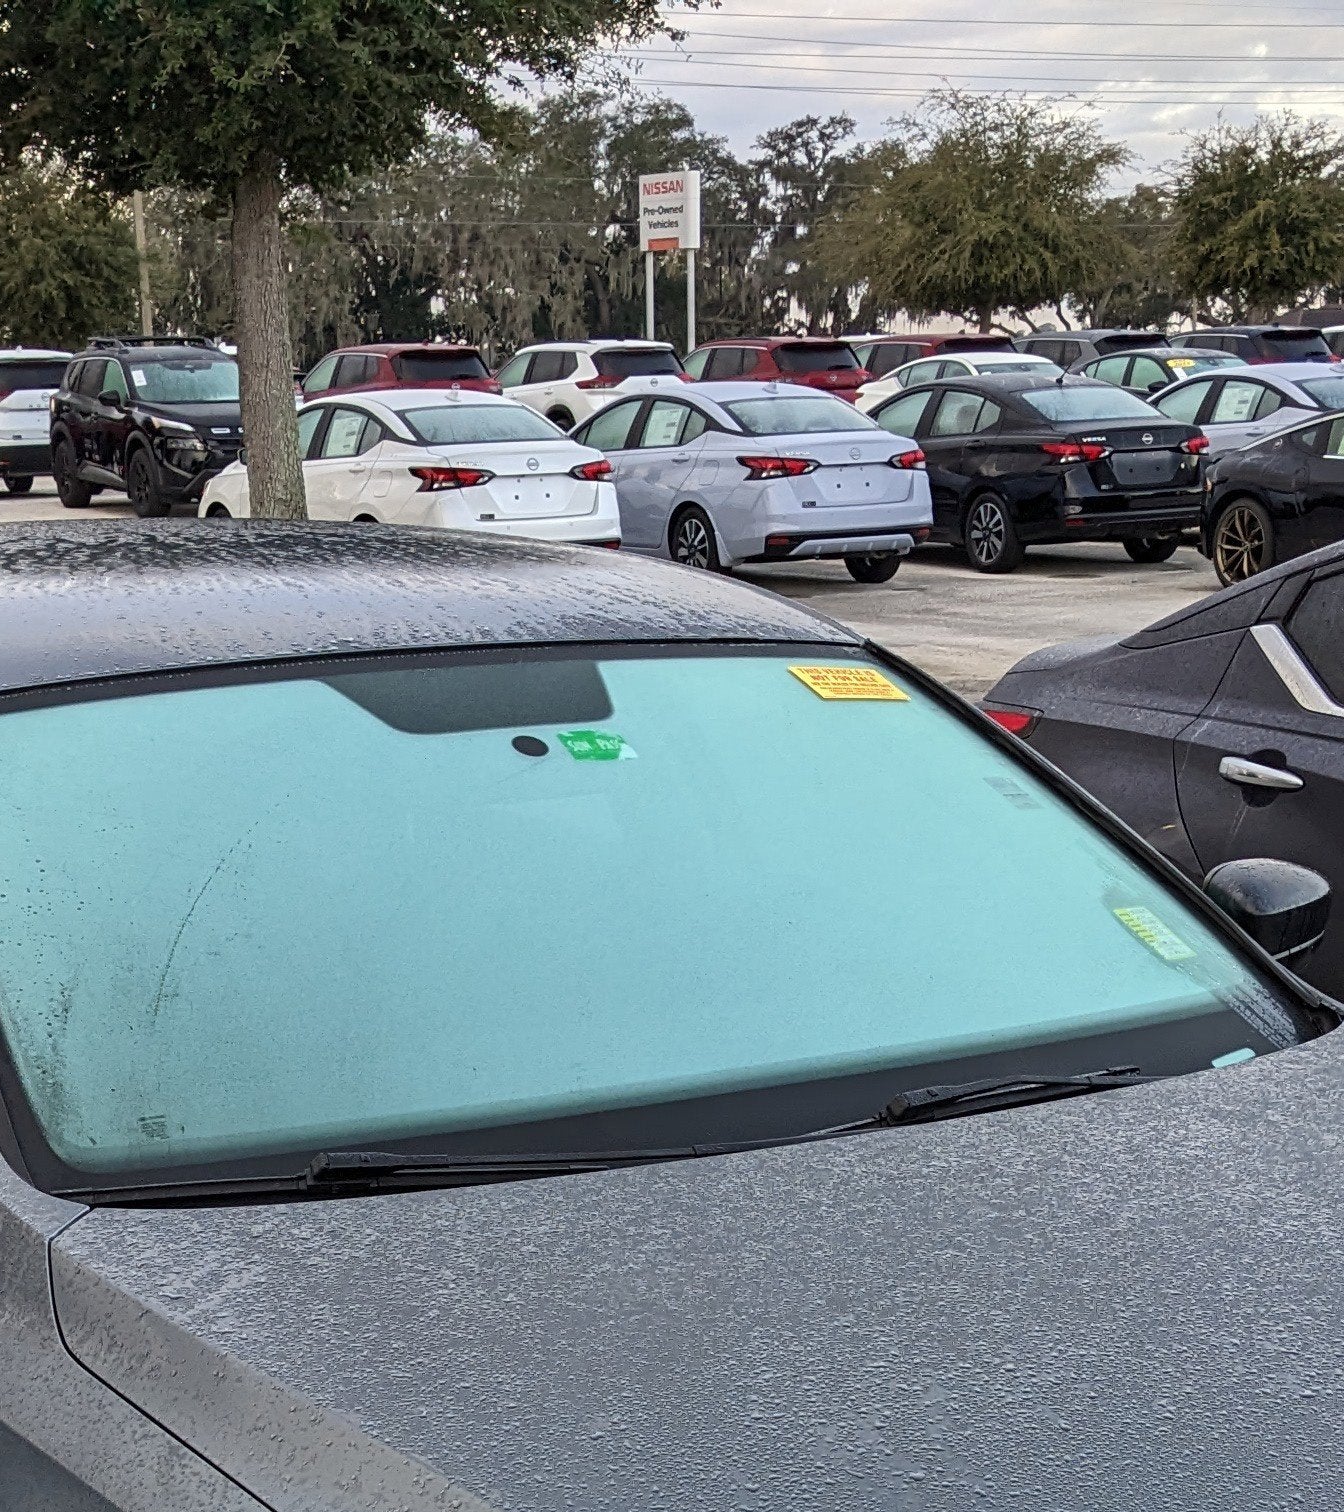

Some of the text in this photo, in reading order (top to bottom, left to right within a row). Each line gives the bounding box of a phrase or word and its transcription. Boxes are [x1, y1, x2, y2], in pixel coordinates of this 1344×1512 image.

[642, 179, 684, 195] NISSAN
[643, 205, 684, 216] Pre-Owned
[648, 219, 679, 230] Vehicles
